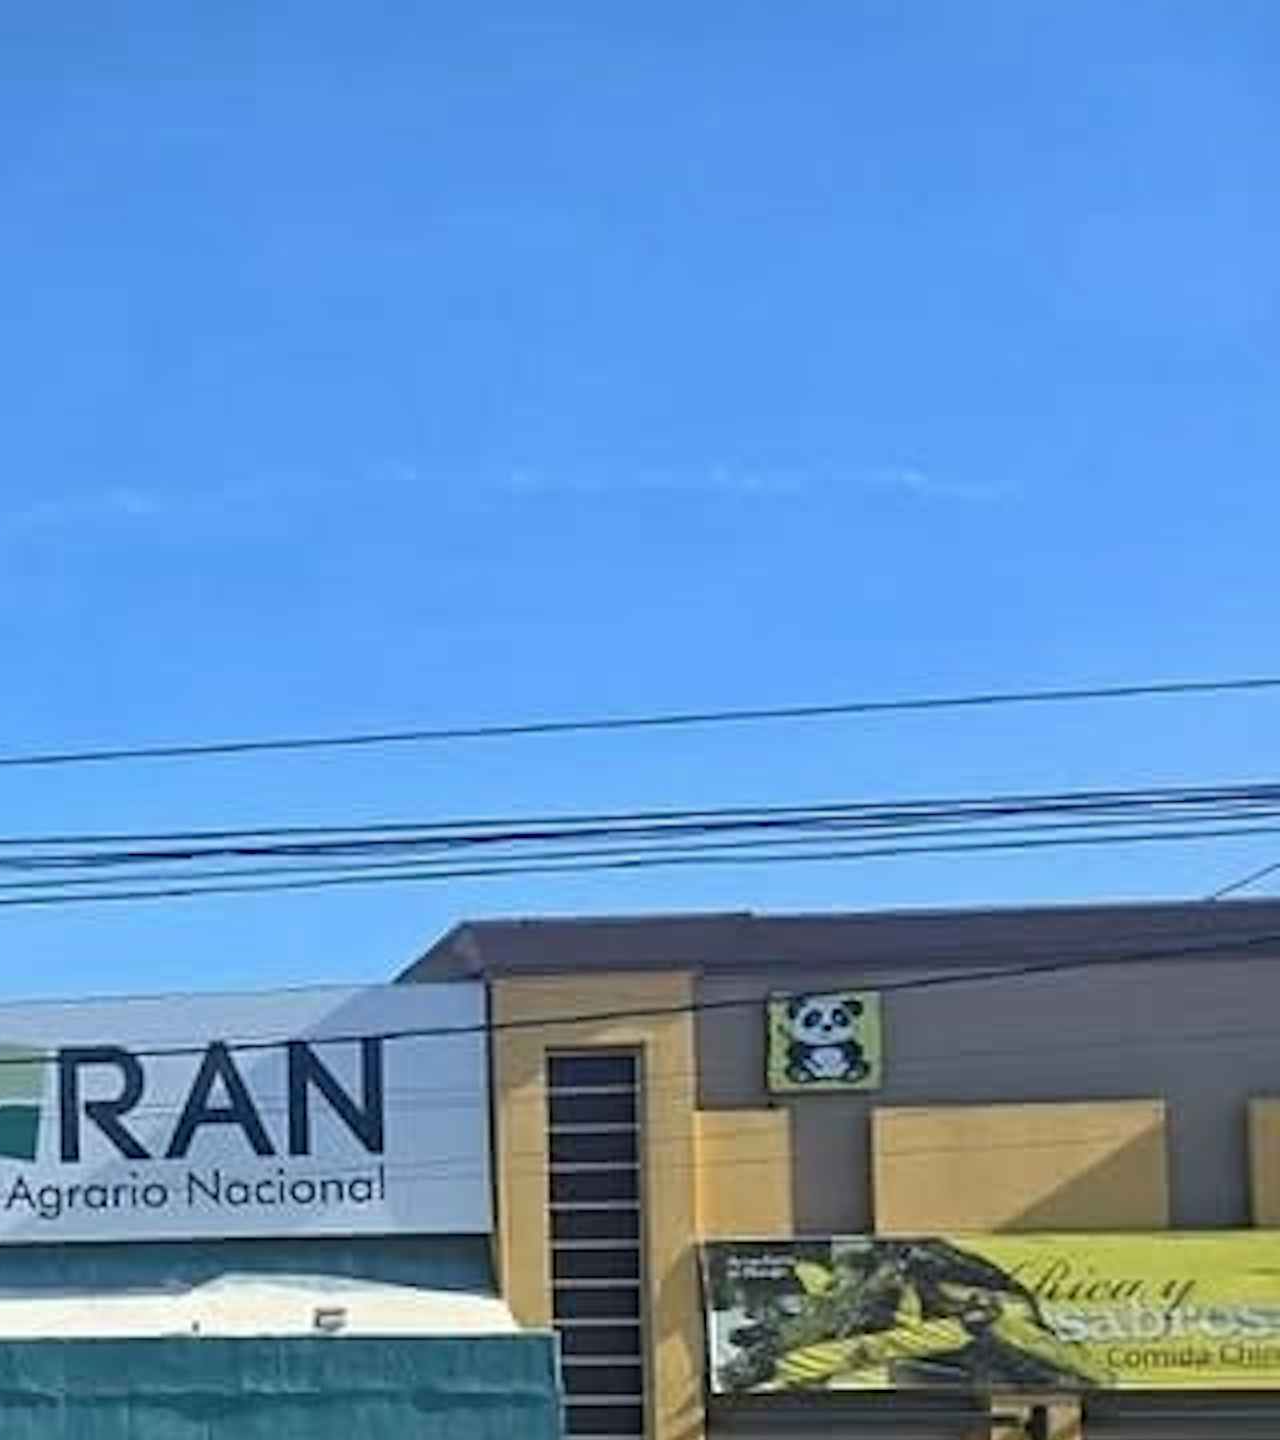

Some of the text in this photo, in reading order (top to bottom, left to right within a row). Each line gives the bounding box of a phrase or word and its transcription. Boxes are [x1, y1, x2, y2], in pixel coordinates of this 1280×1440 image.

[58, 1038, 385, 1163] RAN
[3, 1170, 169, 1218] Agrario
[186, 1163, 386, 1208] Nacional
[1106, 1346, 1212, 1370] Comida
